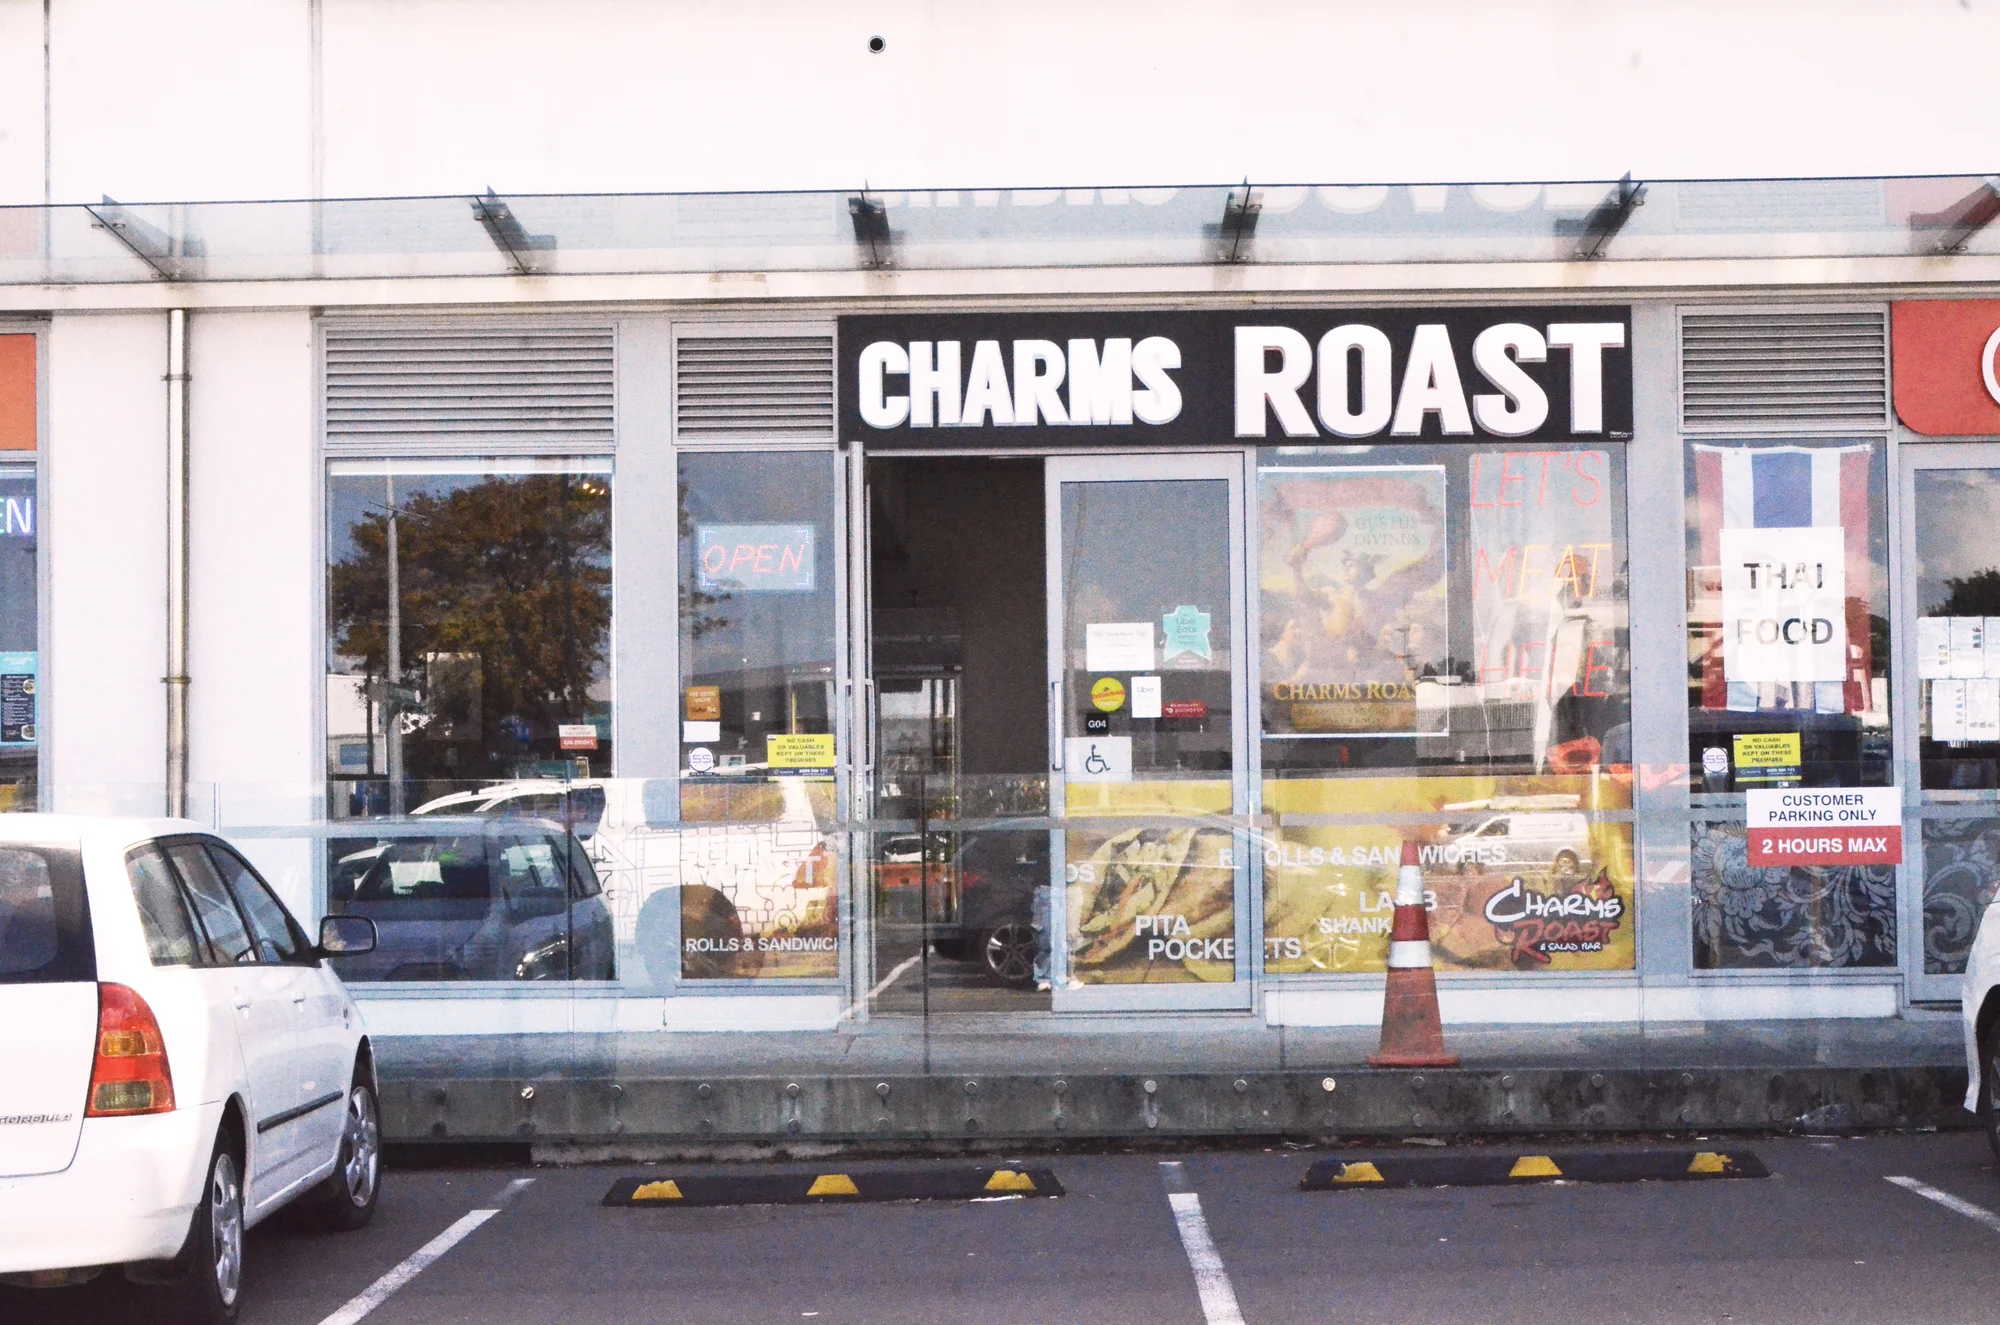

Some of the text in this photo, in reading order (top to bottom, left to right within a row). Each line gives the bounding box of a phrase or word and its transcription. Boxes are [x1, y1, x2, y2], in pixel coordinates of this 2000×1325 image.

[858, 322, 1625, 438] CHARMS ROAST
[1470, 451, 1603, 507] LET'S
[0, 497, 31, 534] N
[703, 544, 805, 573] OPEN
[1473, 544, 1613, 601] MEAT
[1743, 562, 1823, 589] THAI
[1737, 617, 1834, 645] FOOD
[1477, 640, 1615, 698] HERE
[1273, 681, 1362, 700] CHARMS
[1088, 720, 1107, 728] G04
[1782, 794, 1864, 806] CUSTOMER
[1769, 809, 1877, 822] PARKING ONLY
[1330, 846, 1347, 866] &
[1352, 844, 1507, 866] SANWICHES
[1762, 837, 1887, 854] 2 HOURS MAX
[1359, 891, 1438, 913] LAB
[1485, 879, 1621, 923] CHARMS
[1135, 914, 1191, 936] PITA
[686, 938, 739, 952] ROLLS
[743, 938, 755, 951] &
[1513, 919, 1620, 964] ROAST
[1548, 942, 1578, 951] SALAD
[1581, 942, 1602, 951] BAR
